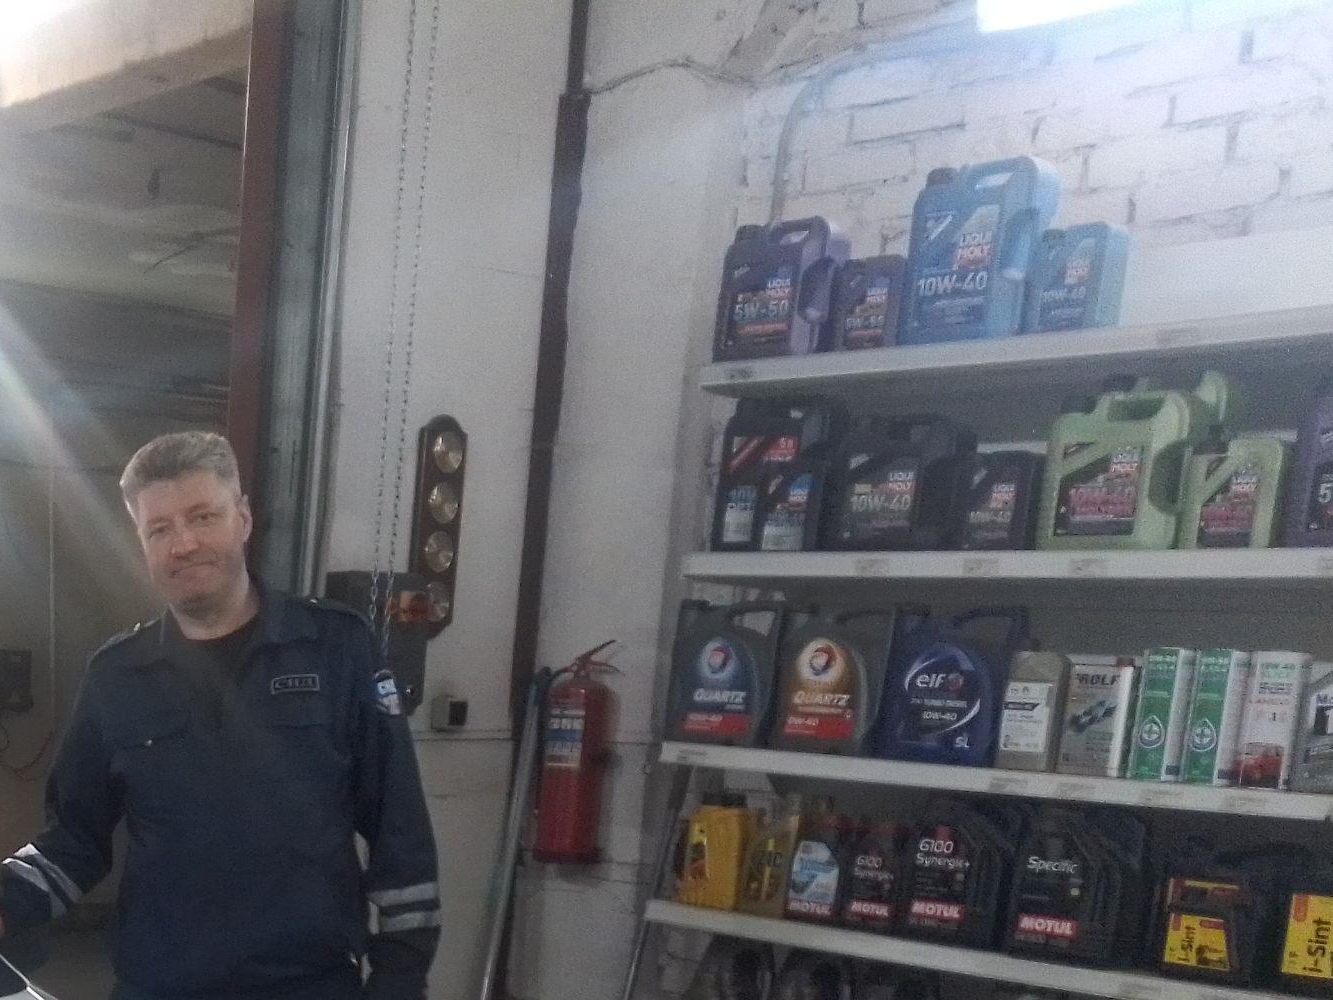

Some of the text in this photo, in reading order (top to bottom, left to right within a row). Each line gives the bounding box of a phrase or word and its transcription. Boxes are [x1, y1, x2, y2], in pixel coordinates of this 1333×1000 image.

[960, 230, 992, 245] LIQUI
[957, 245, 991, 260] MOLY
[918, 271, 988, 296] 10W-40
[734, 300, 790, 320] 5W-50
[850, 494, 911, 512] 10W-40
[916, 673, 946, 688] elf
[693, 688, 747, 703] QUARTZ
[793, 691, 851, 707] QUARTZ
[788, 901, 832, 917] MOTUL
[851, 902, 889, 917] MOTUL
[912, 902, 961, 919] MOTUL
[1018, 915, 1073, 935] MOTUL
[1302, 917, 1331, 973] i-Sint
